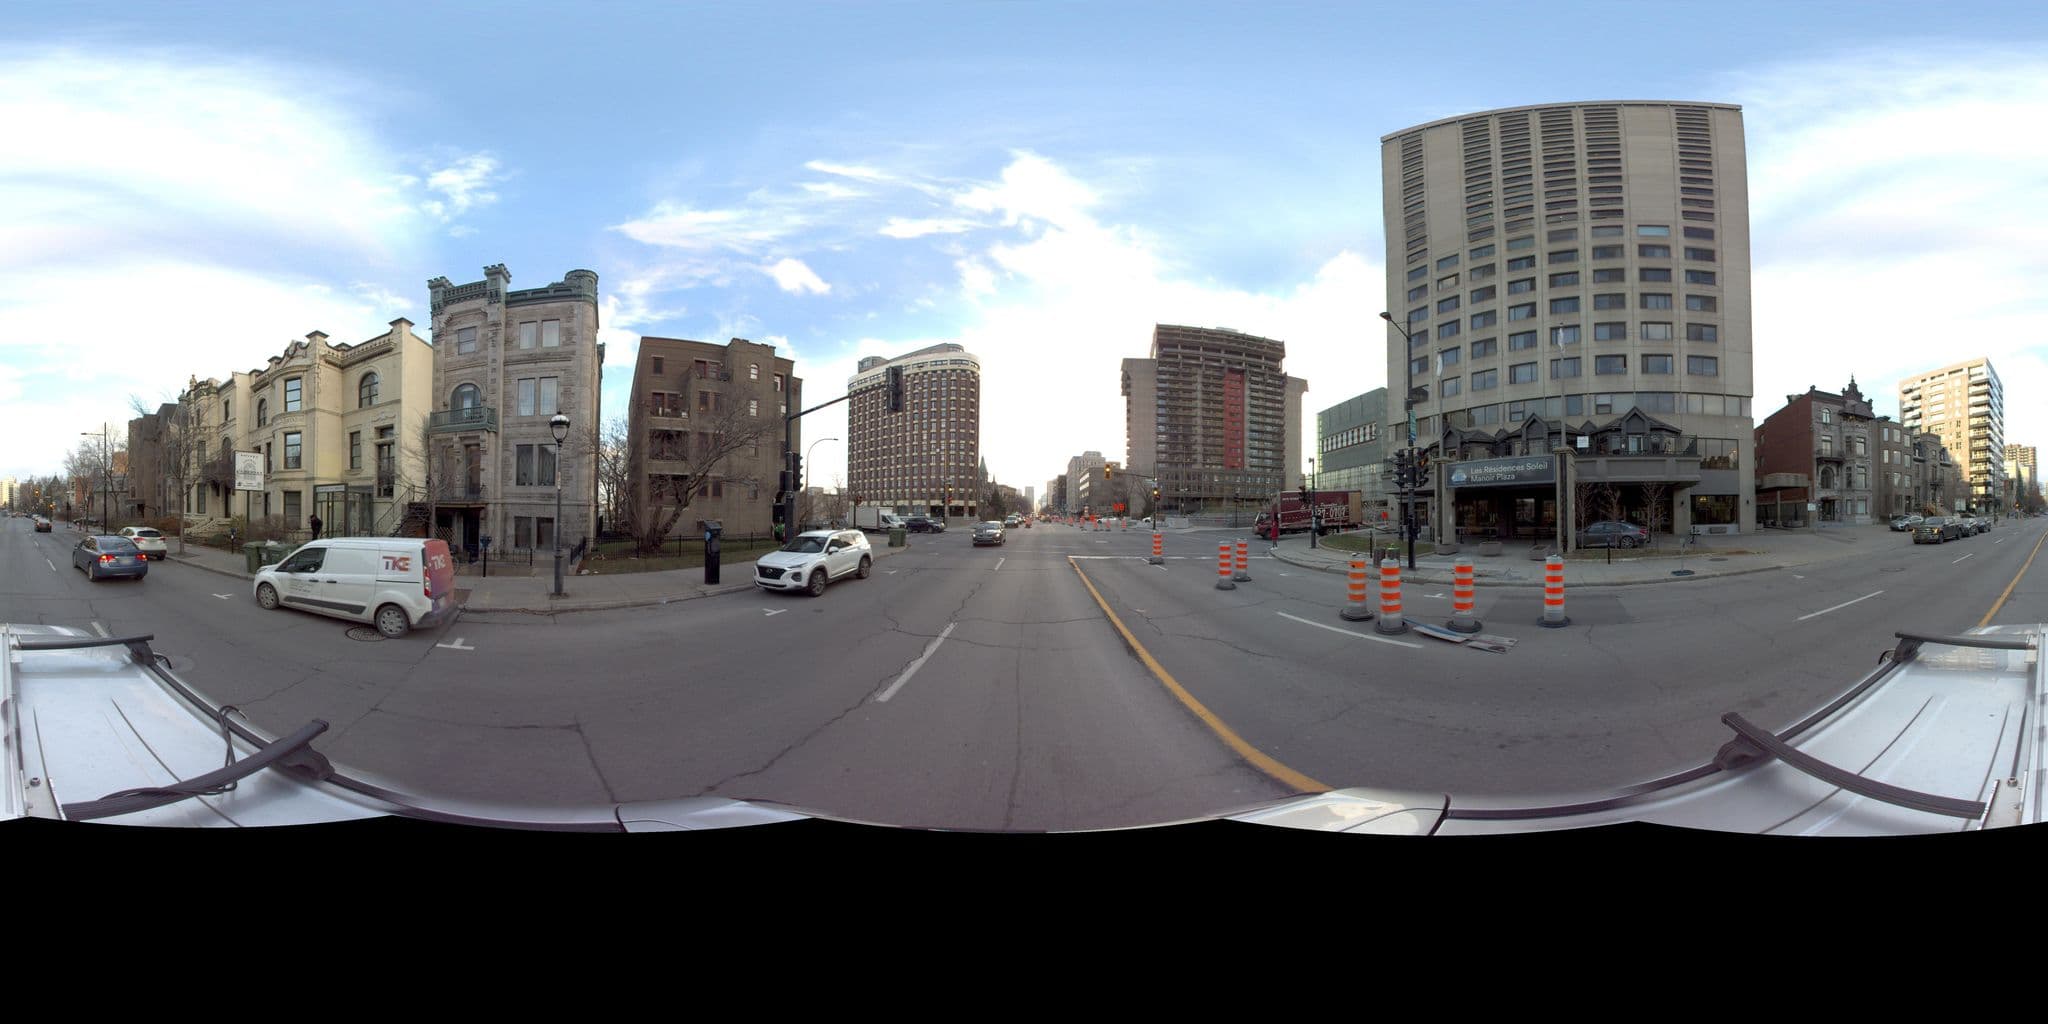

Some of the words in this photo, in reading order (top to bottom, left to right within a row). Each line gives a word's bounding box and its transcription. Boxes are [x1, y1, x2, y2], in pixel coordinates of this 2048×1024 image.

[1526, 462, 1548, 471] Soleil
[1471, 474, 1495, 482] Manoir
[382, 556, 411, 571] TKE
